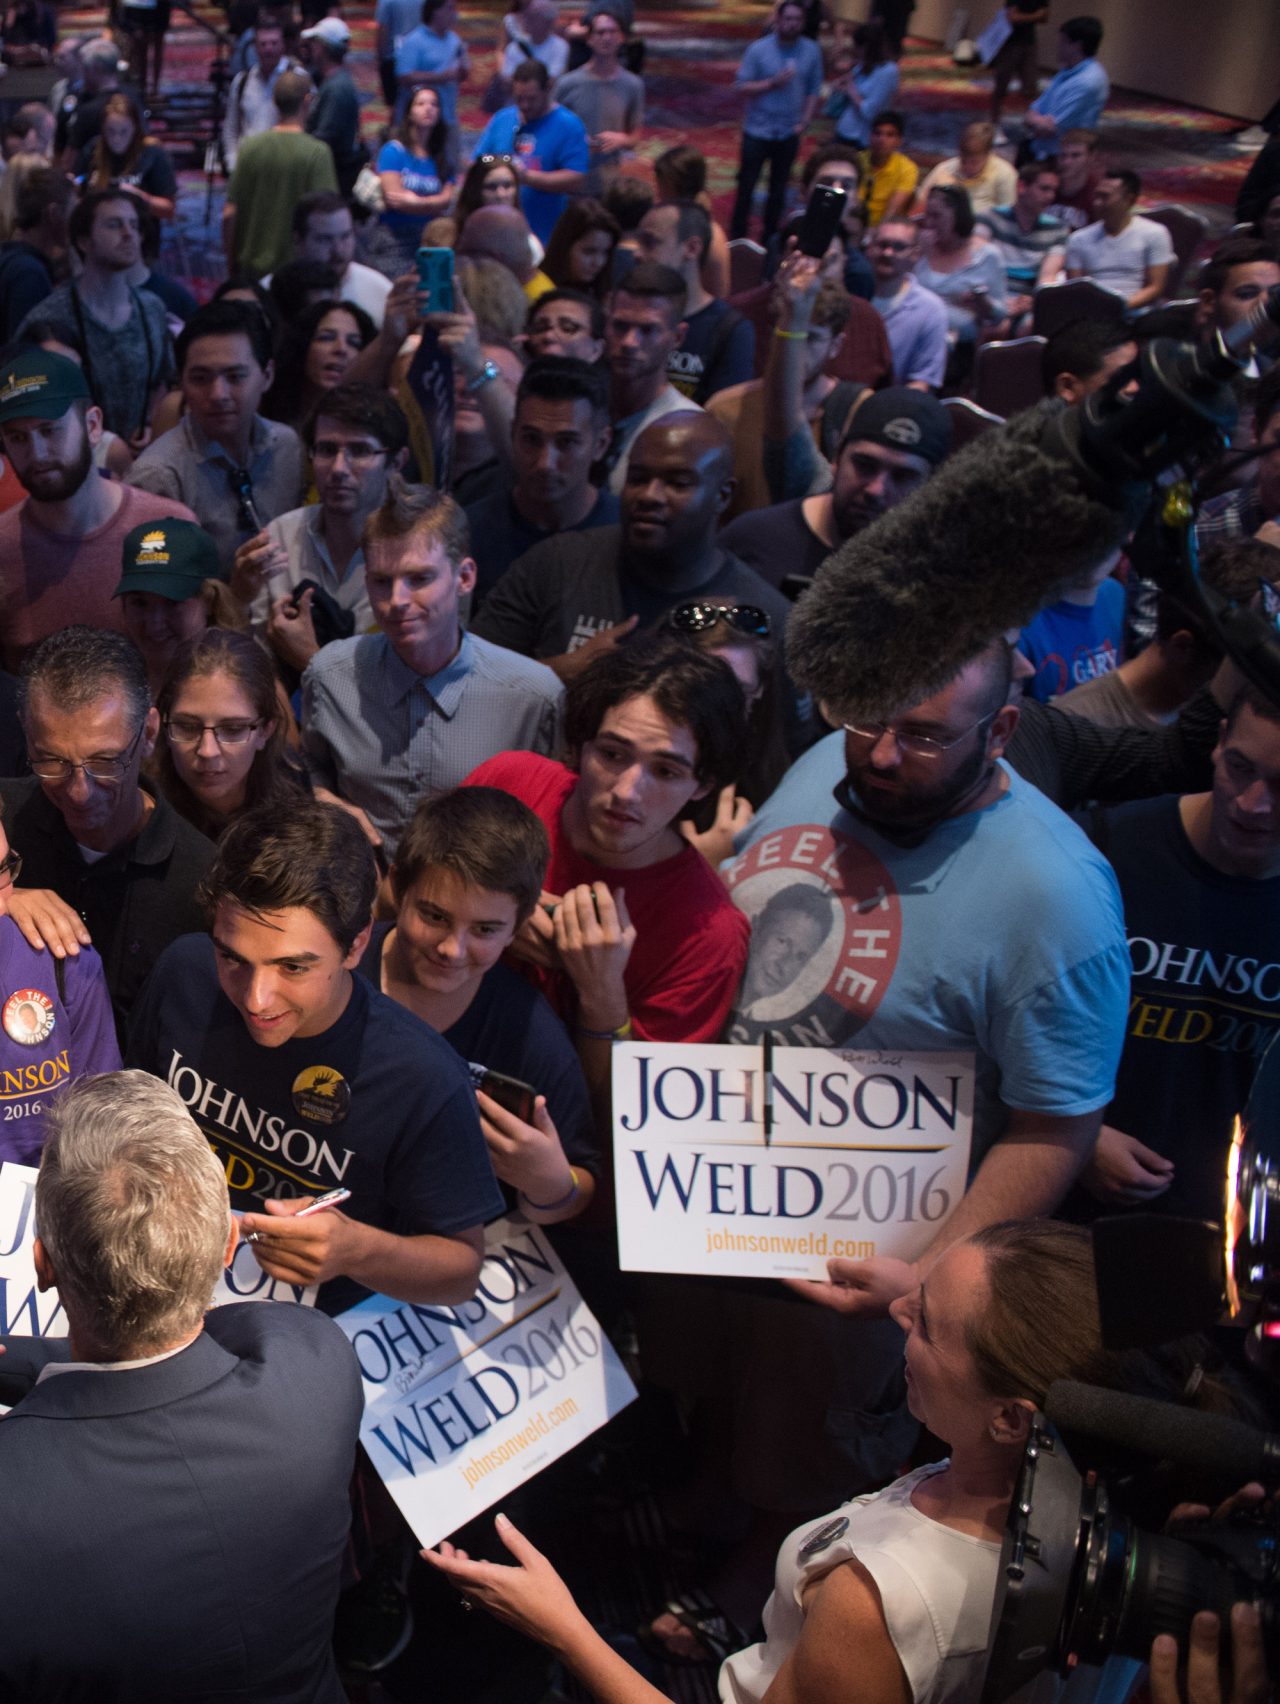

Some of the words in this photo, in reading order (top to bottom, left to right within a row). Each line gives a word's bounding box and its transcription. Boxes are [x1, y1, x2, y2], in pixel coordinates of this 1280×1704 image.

[833, 885, 891, 1005] THE
[1125, 935, 1280, 1002] OHNSO
[1121, 995, 1214, 1044] ELD
[4, 1100, 41, 1122] 2016
[168, 1048, 356, 1182] JOHNSON
[621, 1056, 963, 1132] JOHNSON
[706, 1227, 876, 1259] johnsonweld.com
[352, 1230, 555, 1384] OHNSON
[461, 1396, 580, 1490] johnsonweld.com
